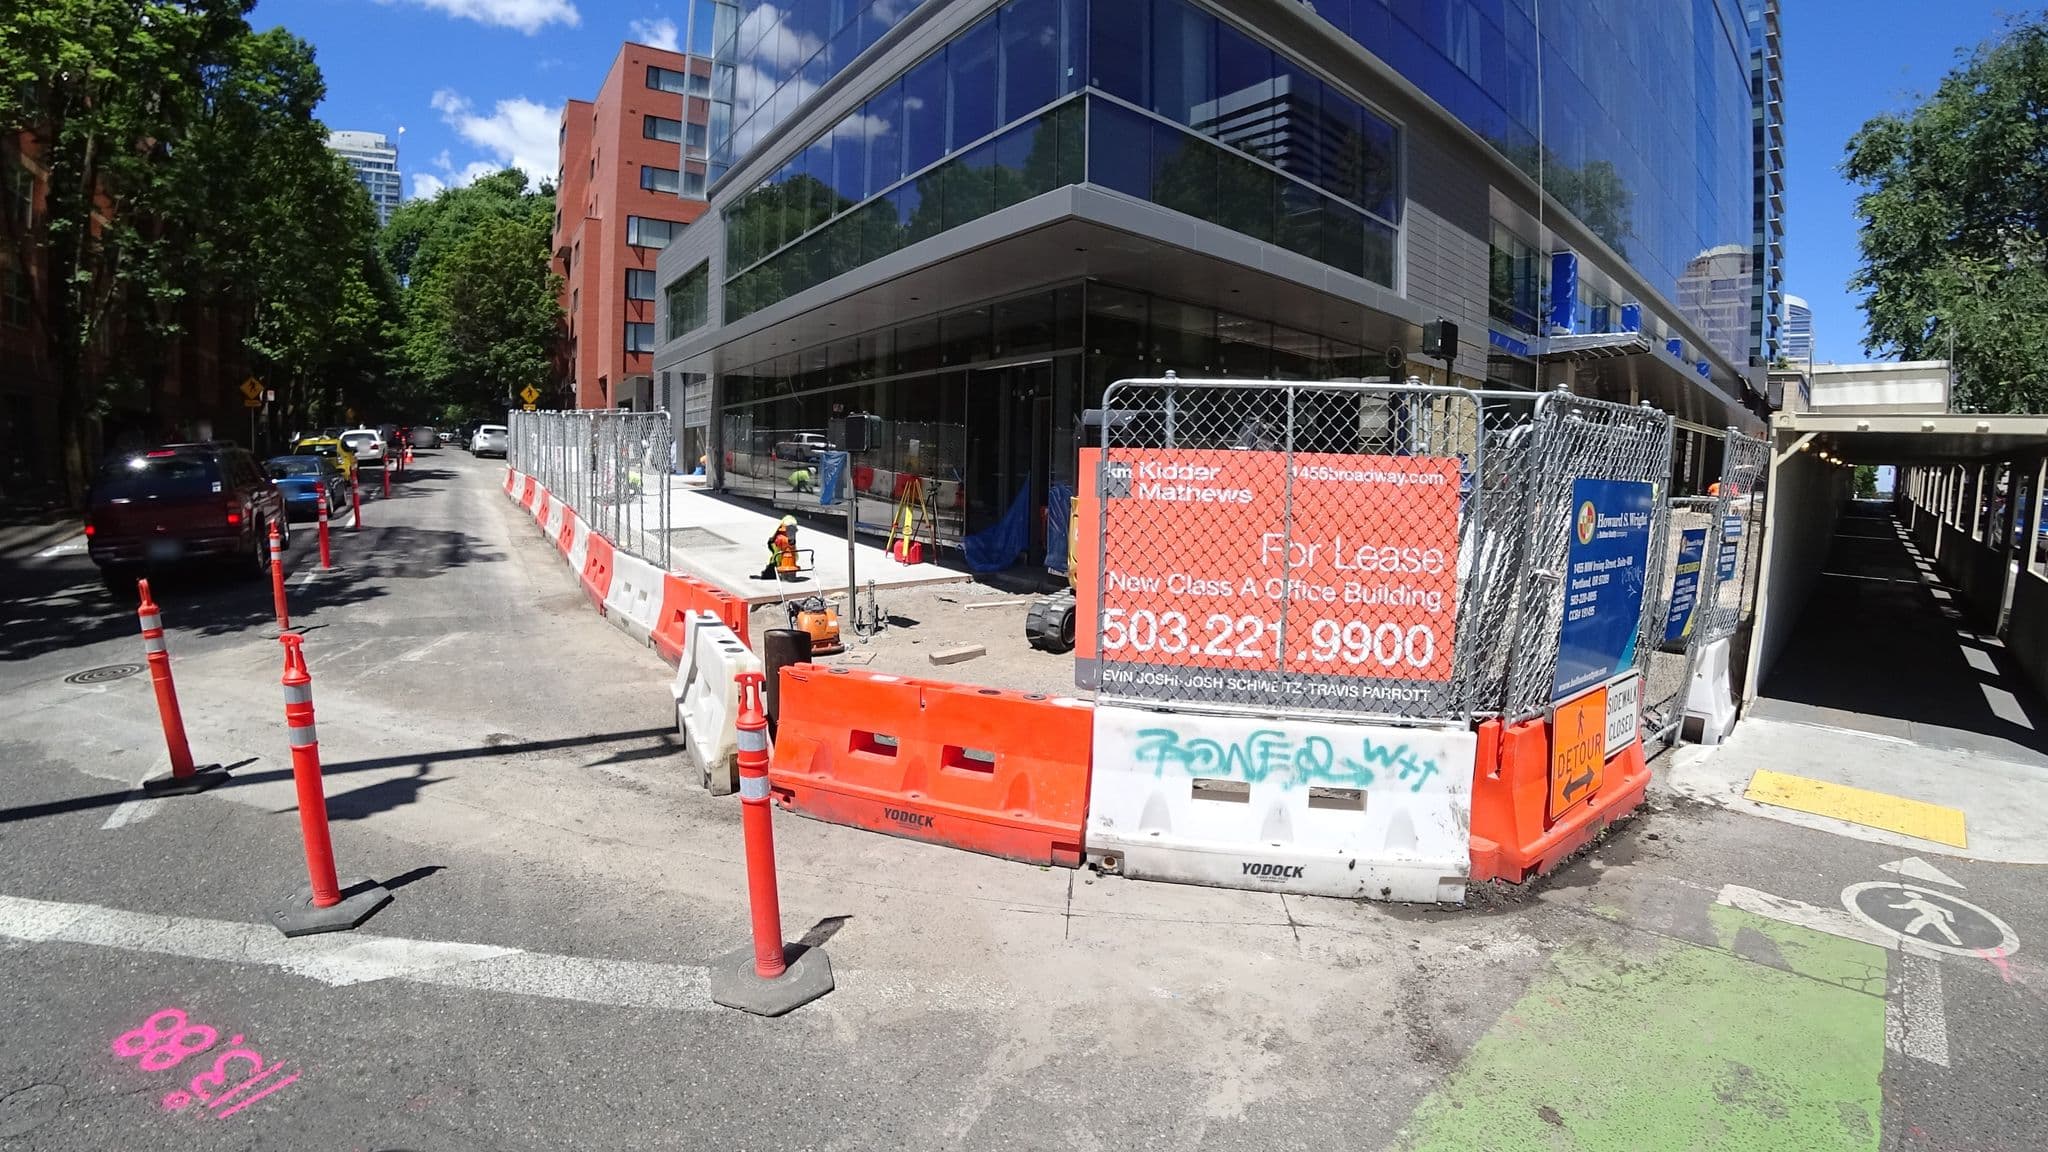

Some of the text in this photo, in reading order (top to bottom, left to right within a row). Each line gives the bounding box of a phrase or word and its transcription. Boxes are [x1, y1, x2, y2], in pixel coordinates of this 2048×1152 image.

[1138, 461, 1221, 481] Kidder
[1138, 482, 1253, 504] Mathews
[1597, 513, 1623, 528] Howard
[1629, 512, 1648, 529] Wright
[1262, 532, 1444, 575] For Lease
[1108, 570, 1442, 612] New Class A Office Building
[1103, 607, 1435, 669] 503.221.9900
[1184, 676, 1224, 689] JOSH
[1308, 683, 1359, 698] TRAVIS
[1362, 685, 1431, 702] PARROTT
[1607, 685, 1637, 716] SIDEWALK
[1608, 714, 1633, 741] CLOSED
[1558, 733, 1602, 779] DETOUR
[884, 807, 935, 828] YODOCK
[1242, 862, 1304, 878] YODOCK
